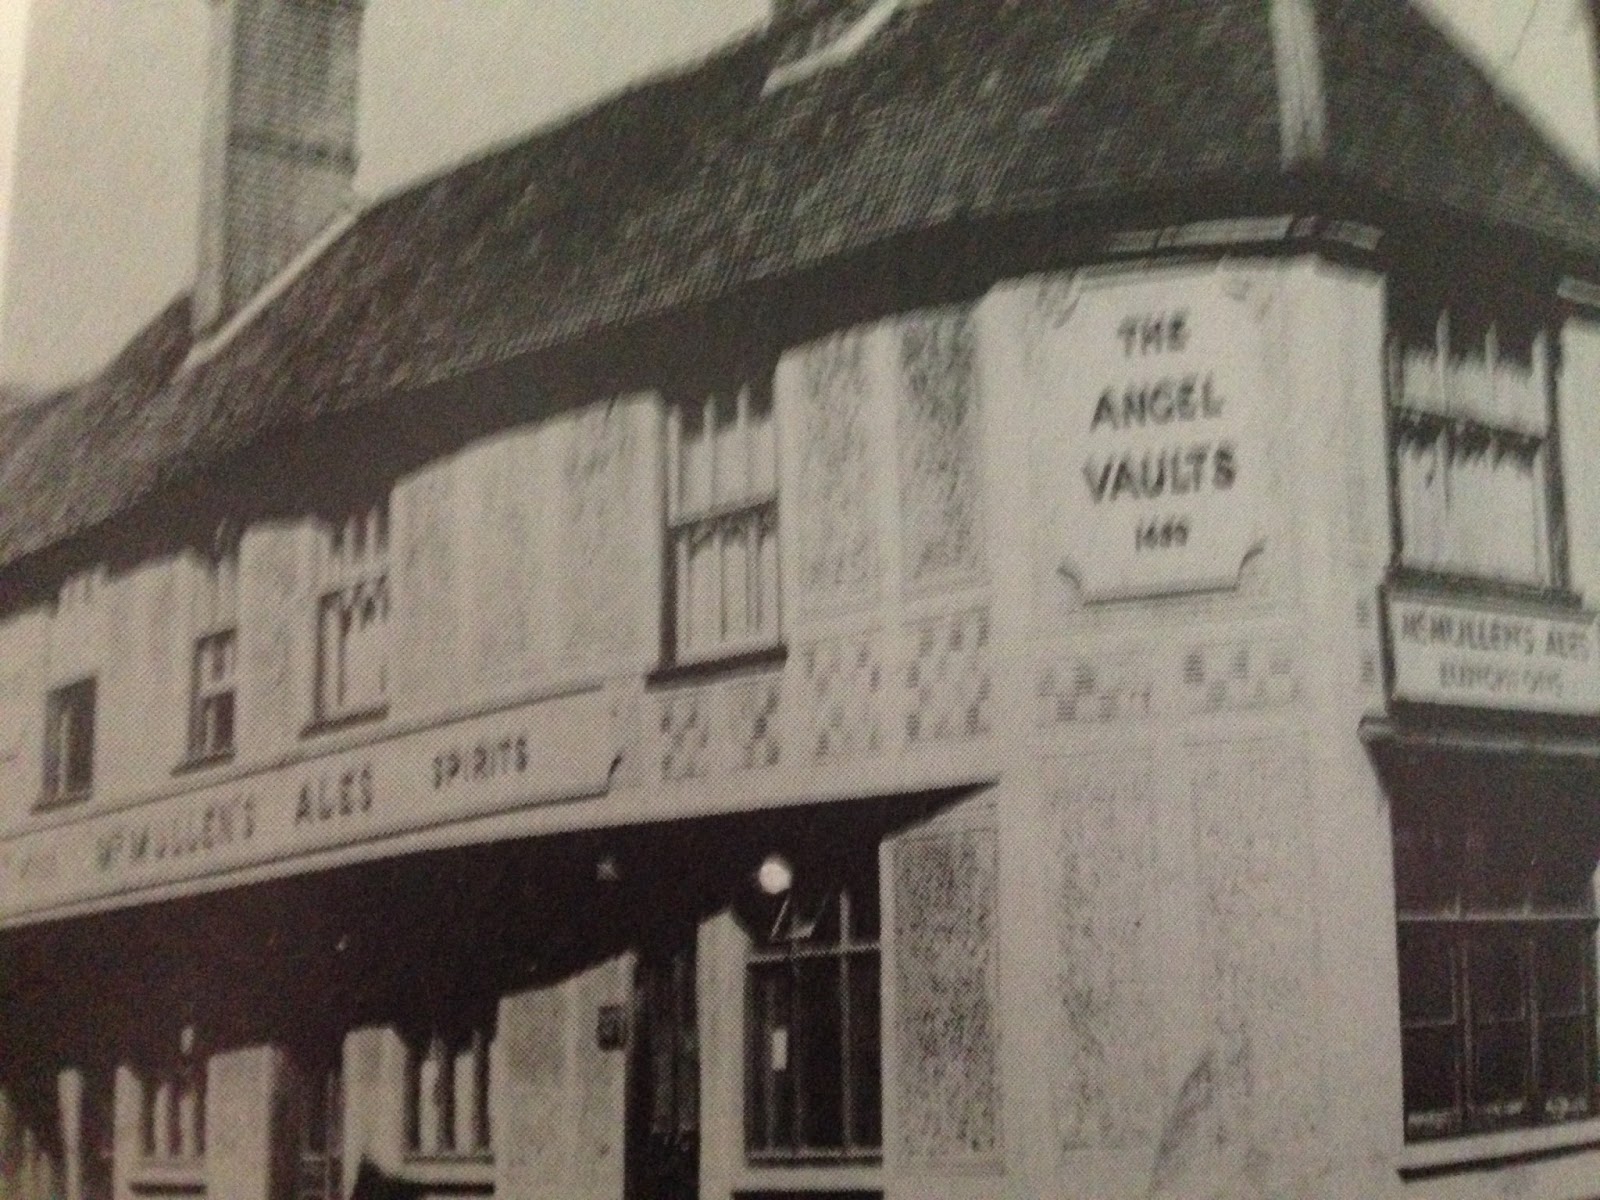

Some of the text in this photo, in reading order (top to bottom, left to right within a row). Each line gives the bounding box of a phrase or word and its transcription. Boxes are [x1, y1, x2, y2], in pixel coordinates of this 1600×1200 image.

[1117, 309, 1190, 357] THE
[1089, 372, 1224, 432] ANGEL
[1081, 442, 1237, 504] VAULTS
[295, 764, 372, 826] ALES
[433, 735, 528, 790] SPIRITS
